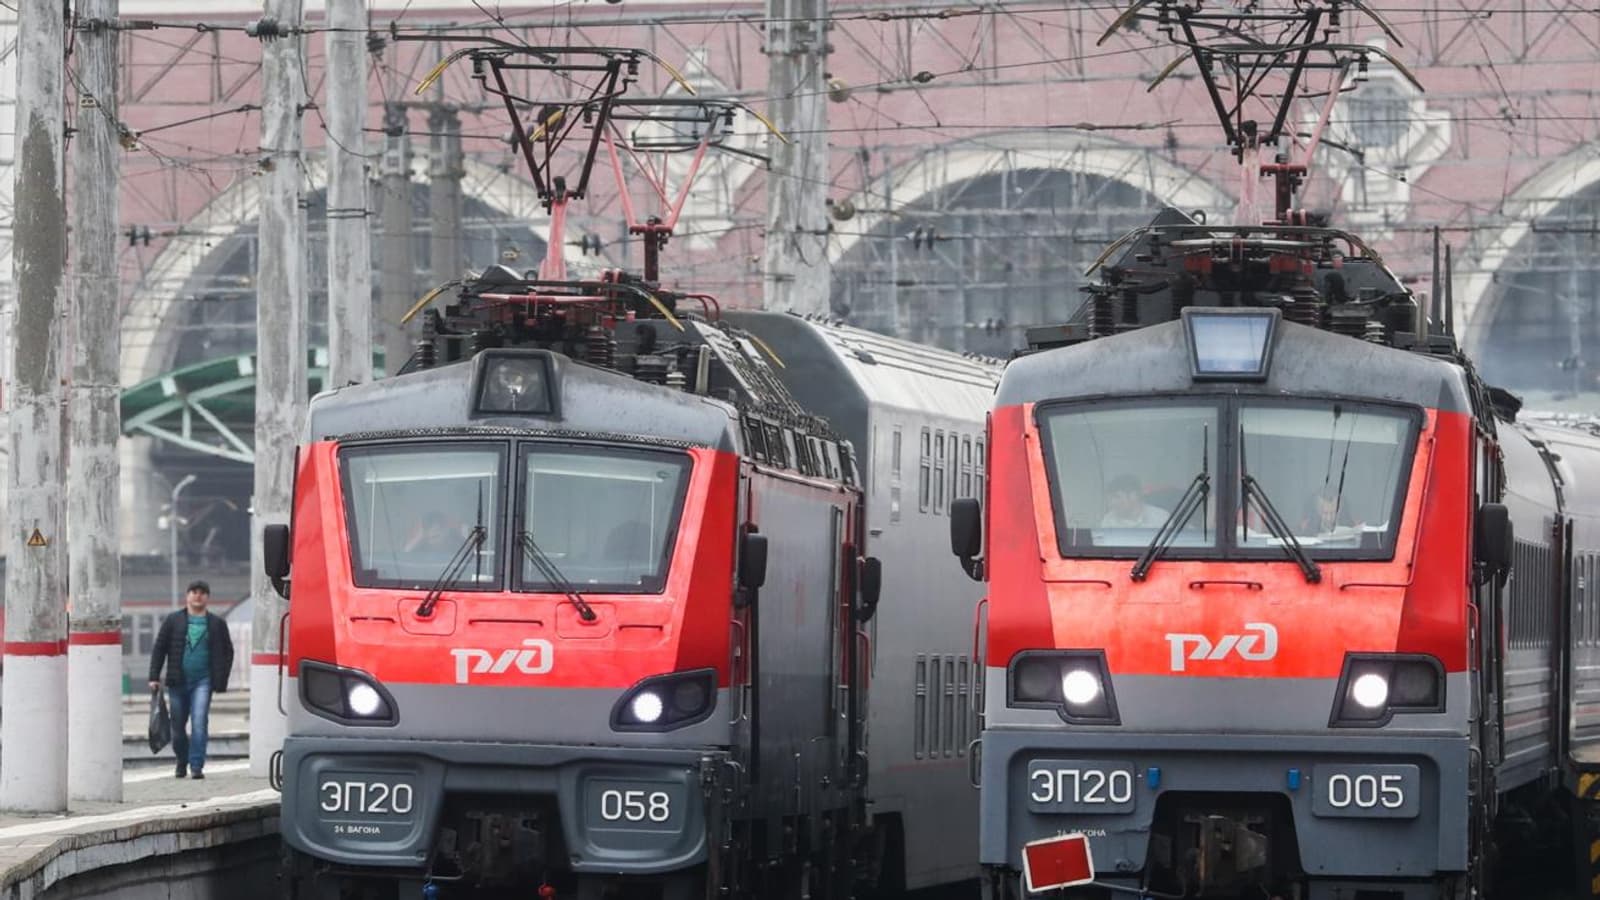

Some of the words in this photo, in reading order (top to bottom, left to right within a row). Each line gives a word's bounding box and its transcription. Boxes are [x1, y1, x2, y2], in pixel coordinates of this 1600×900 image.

[321, 781, 413, 813] ЭП20
[1031, 769, 1132, 803] ЭП20
[1328, 774, 1404, 808] 005
[601, 789, 669, 821] 058
